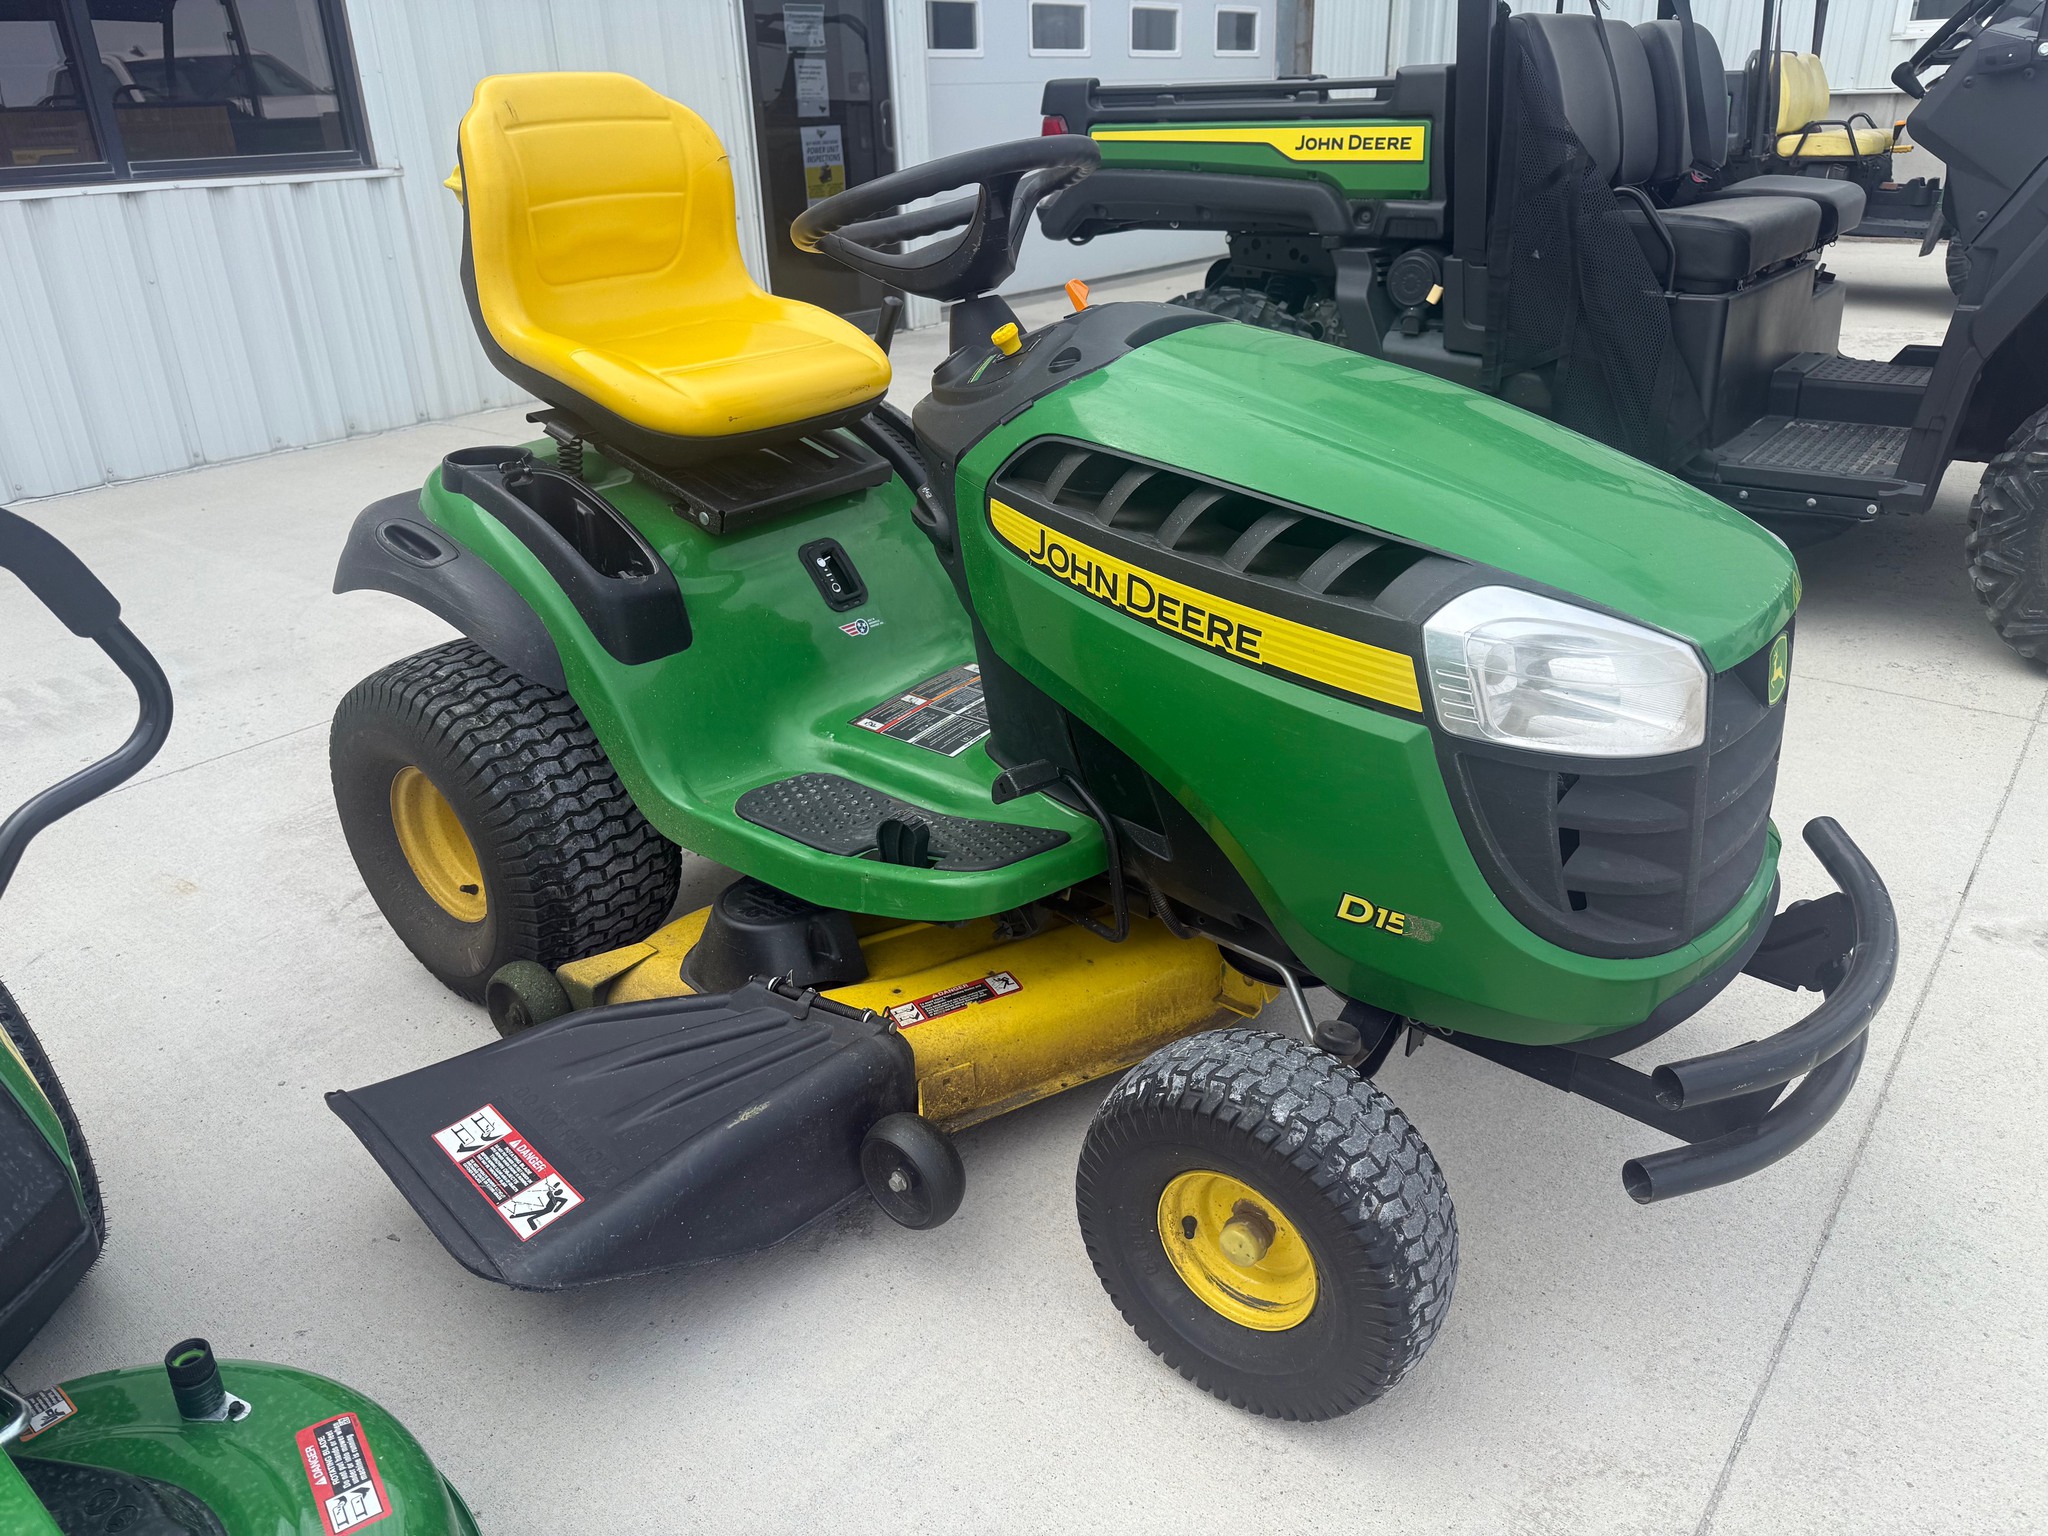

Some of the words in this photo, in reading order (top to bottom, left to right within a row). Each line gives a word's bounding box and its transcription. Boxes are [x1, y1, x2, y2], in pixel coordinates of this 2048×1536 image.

[1295, 134, 1345, 151] JOHN
[1348, 134, 1412, 151] DEERE
[1029, 529, 1119, 601] JOHN
[1126, 575, 1264, 660] DEERE
[937, 983, 969, 997] DANGER
[502, 1146, 522, 1164] ROTATING
[518, 1162, 533, 1175] BLADE
[515, 1143, 548, 1173] DANGER
[325, 1429, 335, 1441] feet
[337, 1434, 348, 1452] mower
[317, 1435, 331, 1456] BLADE
[330, 1445, 342, 1462] hands
[305, 1445, 324, 1479] DANGER
[323, 1454, 340, 1486] ROTATING
[336, 1460, 346, 1471] put
[339, 1469, 348, 1480] not
[348, 1468, 359, 1485] under
[341, 1478, 351, 1489] Do
